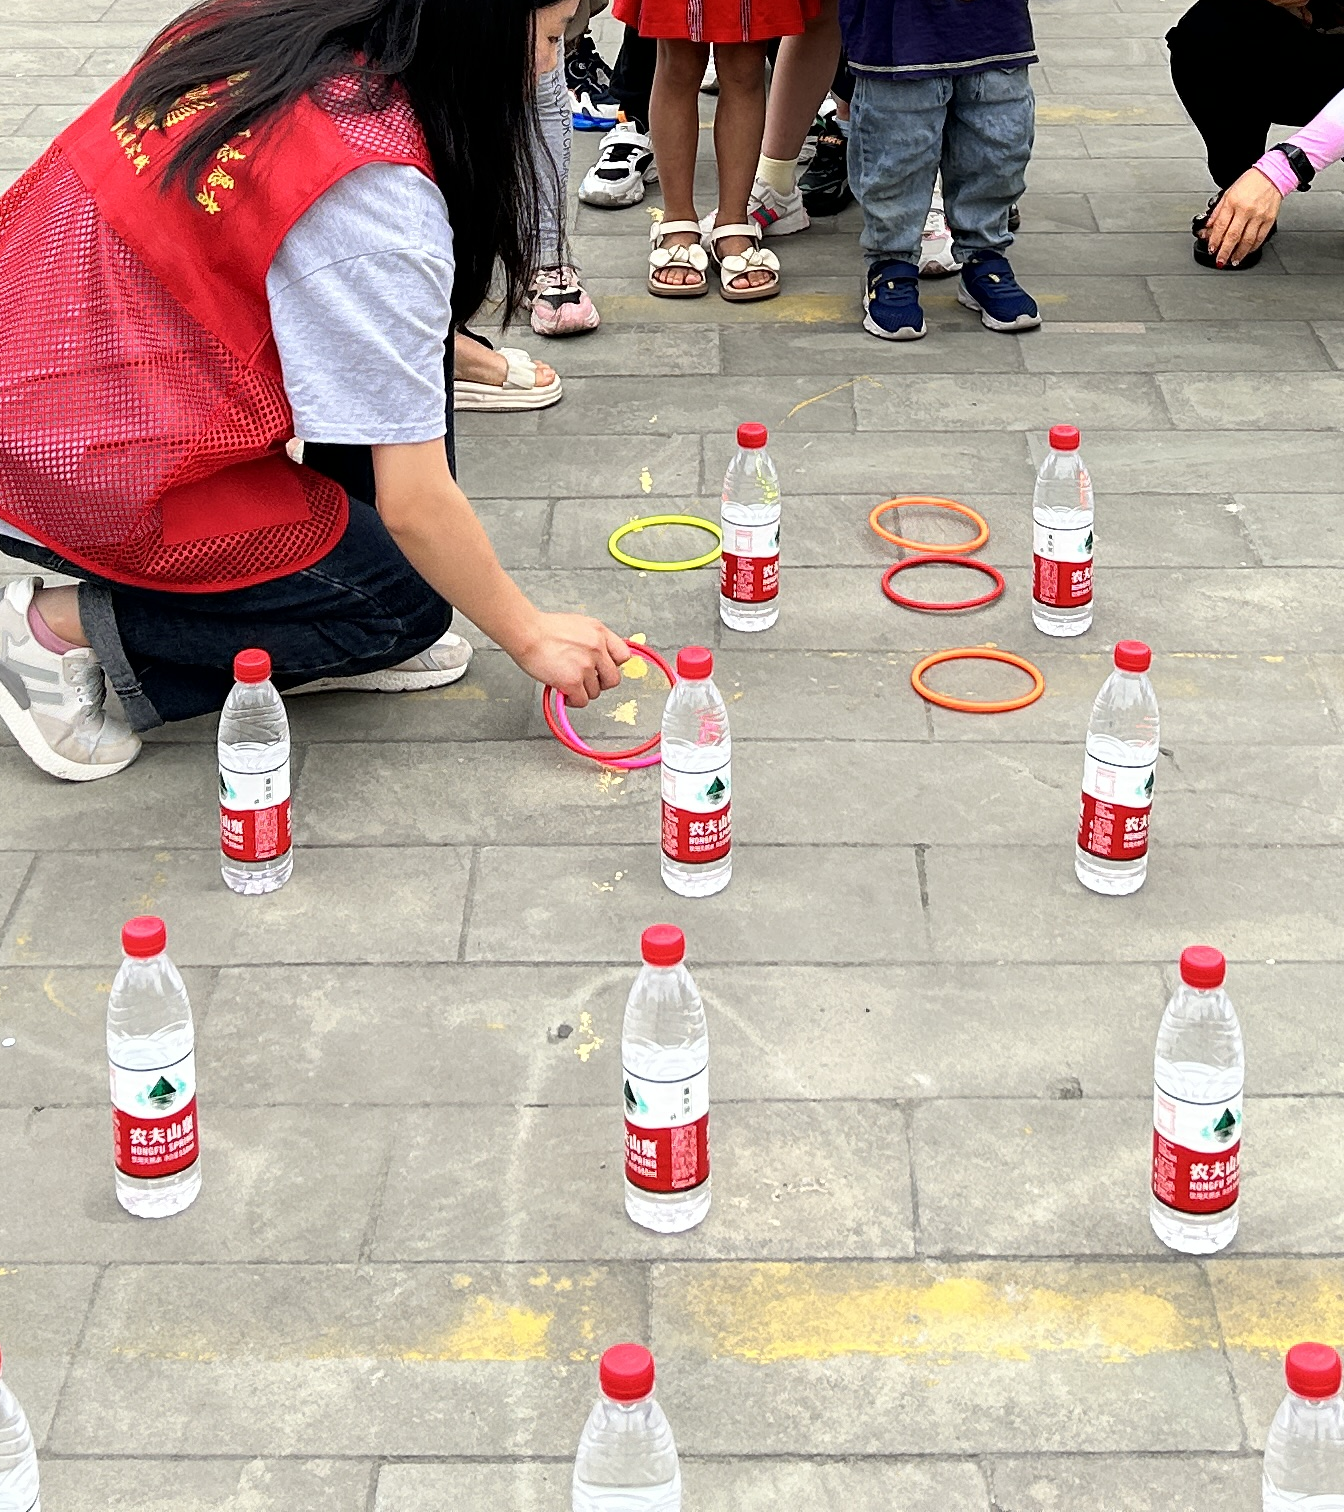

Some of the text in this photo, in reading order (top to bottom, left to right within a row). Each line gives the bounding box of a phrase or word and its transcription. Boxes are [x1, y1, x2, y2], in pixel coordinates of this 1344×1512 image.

[196, 128, 252, 215] 志愿者
[1124, 814, 1149, 833] 农夫
[130, 1111, 194, 1146] 农夫山泉
[130, 1144, 166, 1156] NONGFU
